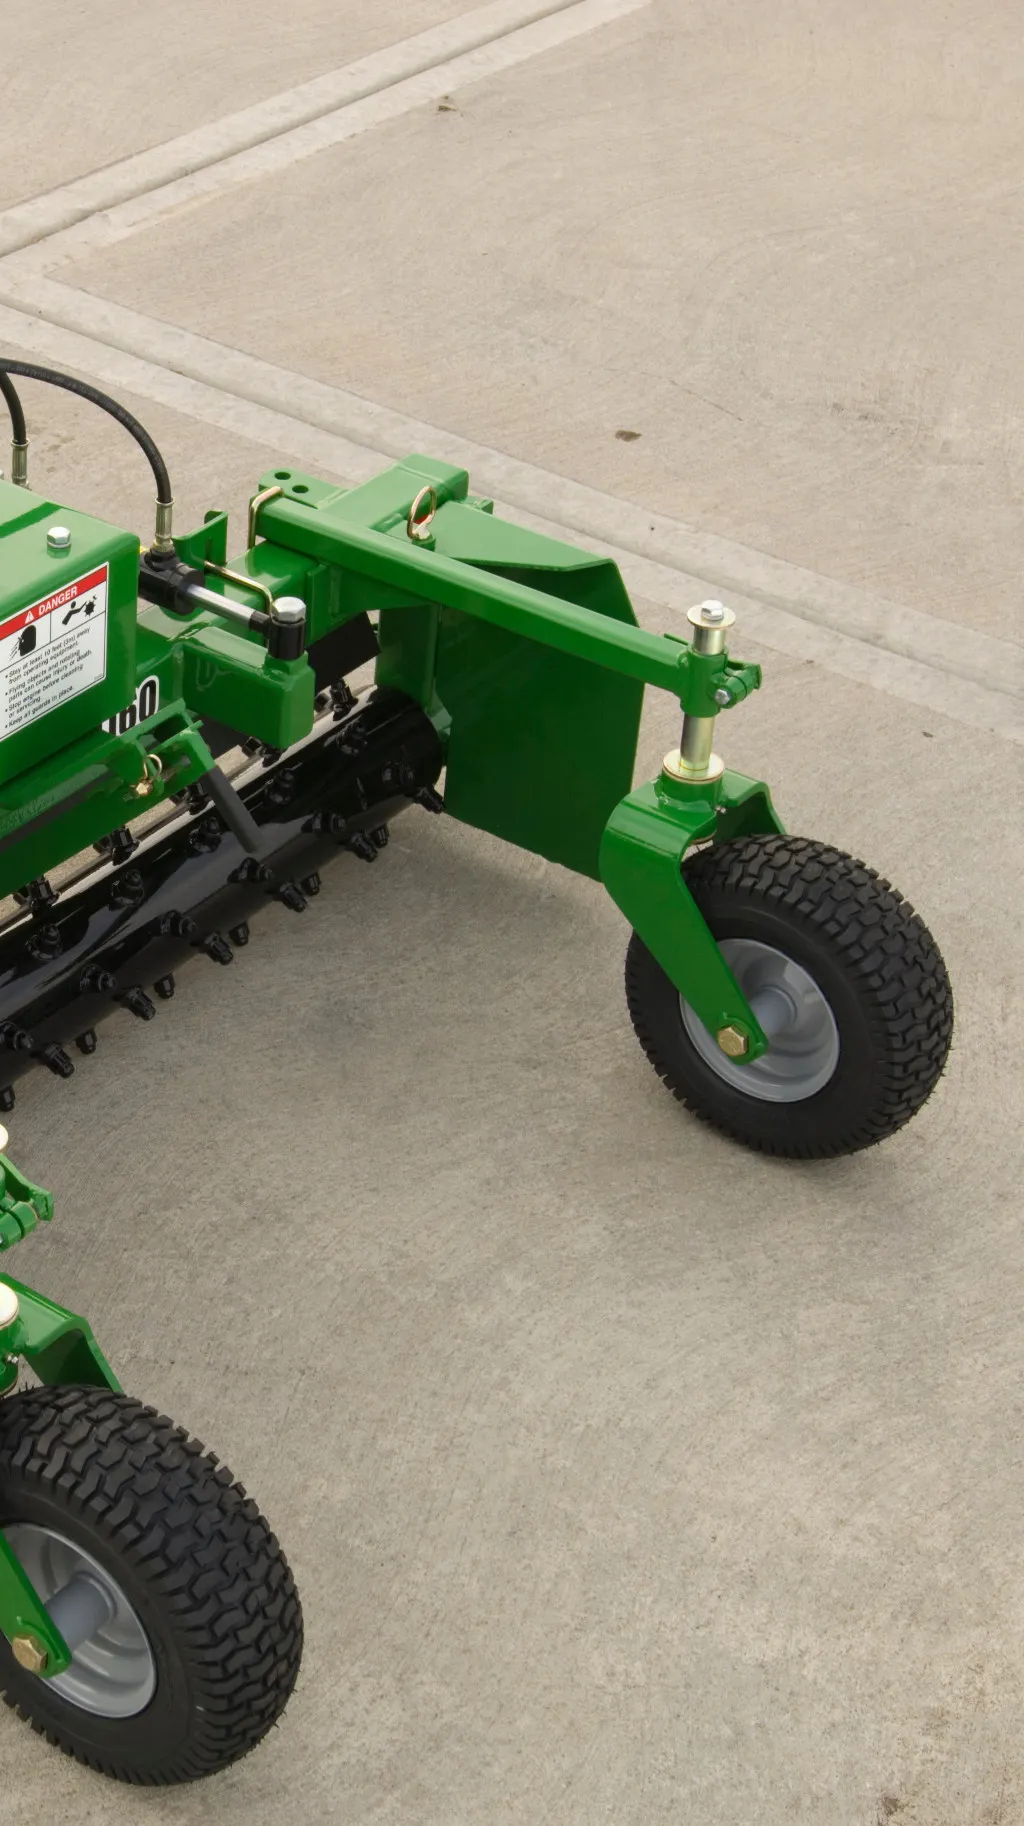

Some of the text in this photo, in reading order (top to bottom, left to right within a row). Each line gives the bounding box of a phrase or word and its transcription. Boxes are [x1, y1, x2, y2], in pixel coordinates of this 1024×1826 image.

[38, 585, 78, 616] DANGER
[9, 666, 21, 677] Stay
[30, 654, 42, 665] least
[9, 674, 21, 684] from
[24, 659, 48, 677] operating
[9, 681, 25, 694] Flying
[27, 668, 46, 684] objects
[48, 662, 58, 672] and
[9, 692, 22, 703] parts
[25, 684, 34, 693] can
[36, 674, 51, 686] cause
[53, 665, 68, 678] injury
[9, 700, 21, 711] Stop
[23, 688, 41, 703] engine
[43, 677, 59, 691] before
[61, 664, 83, 680] cleaning
[9, 715, 22, 727] Keep
[32, 699, 50, 715] guards
[52, 694, 57, 702] in
